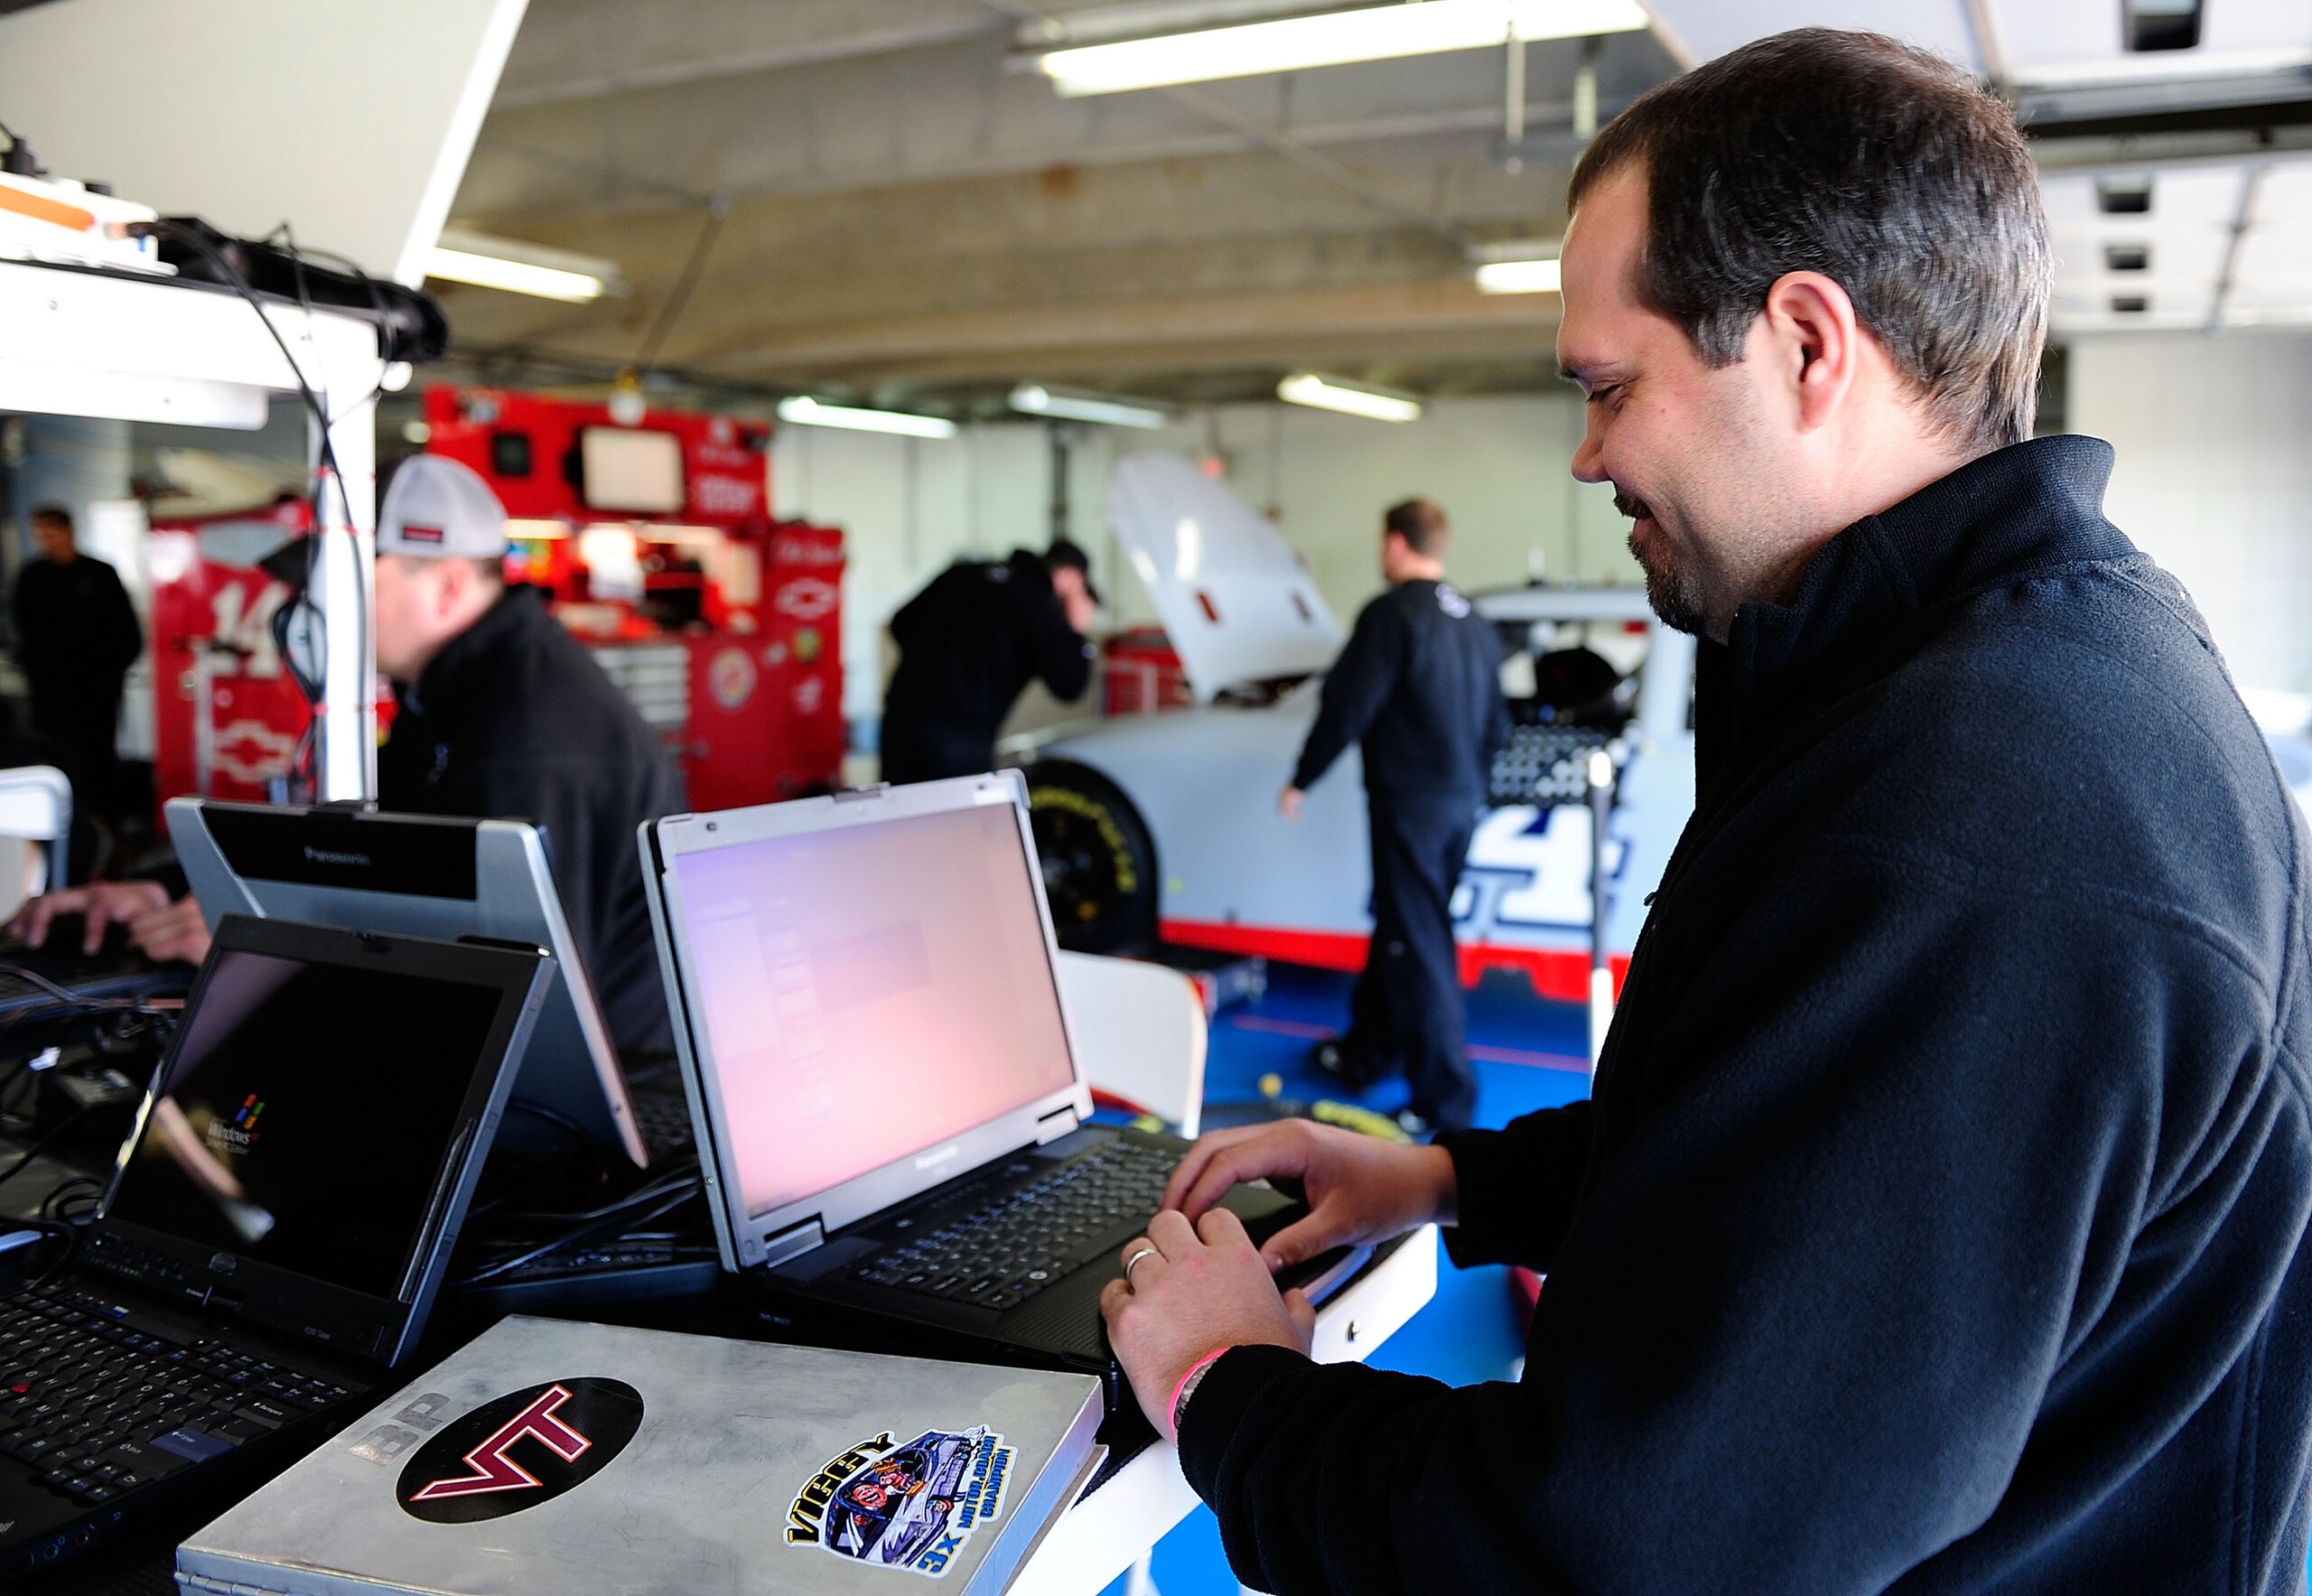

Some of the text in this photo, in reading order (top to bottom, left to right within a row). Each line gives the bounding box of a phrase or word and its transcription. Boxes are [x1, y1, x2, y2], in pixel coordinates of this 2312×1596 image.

[303, 845, 372, 866] Panasonic
[209, 1120, 250, 1144] Windows
[342, 1392, 452, 1468] BP
[408, 1384, 592, 1501] VT
[957, 1435, 997, 1529] MOTOR COACH
[979, 1448, 1012, 1518] CHAMPION
